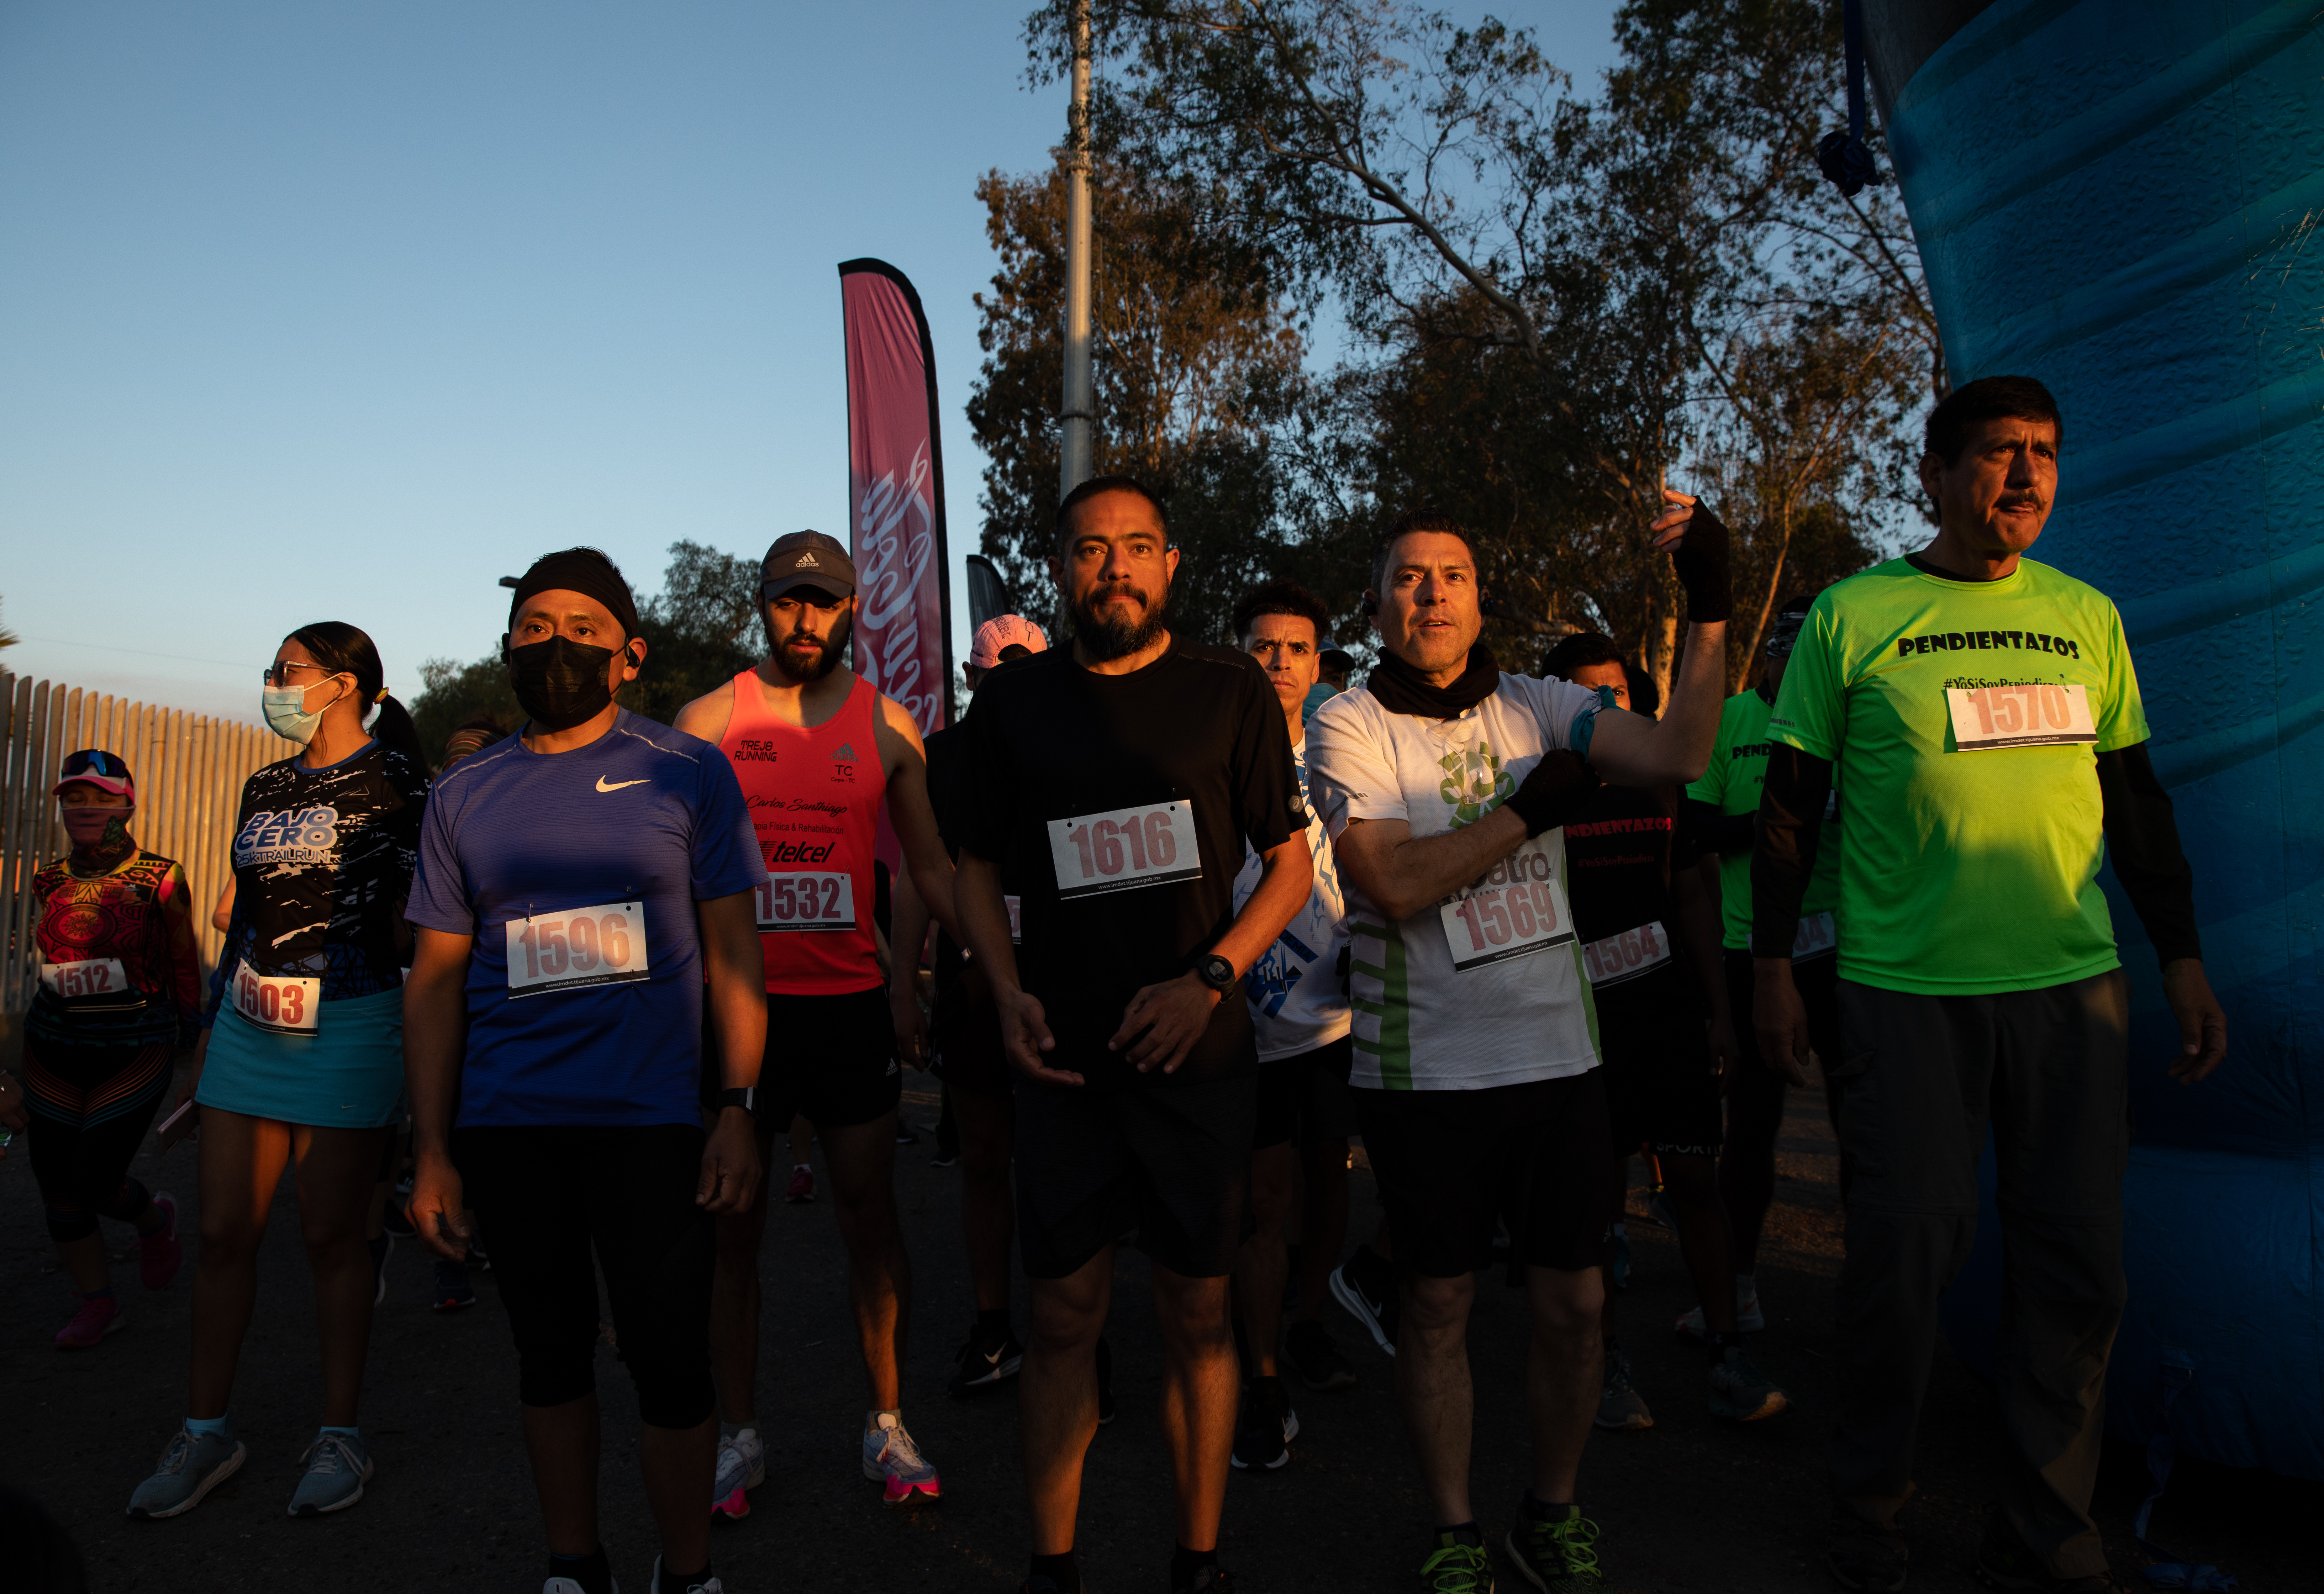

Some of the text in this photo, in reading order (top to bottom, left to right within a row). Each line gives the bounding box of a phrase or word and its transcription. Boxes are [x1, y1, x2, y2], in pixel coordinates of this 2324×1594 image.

[1898, 630, 2080, 660] PENDIENTAZOS
[1968, 685, 2071, 734] 1570
[734, 751, 777, 762] RUNNING
[741, 740, 773, 751] TREJO
[830, 753, 859, 762] adidas
[835, 765, 853, 776] TC
[747, 795, 848, 817] Carlos Santhiago
[245, 809, 334, 831] BAJO
[753, 822, 843, 834] apia Física & Rehabilitación
[1564, 817, 1671, 839] NDIENTAZOS
[236, 826, 333, 850] CERO
[1069, 811, 1176, 878] 1616
[773, 841, 836, 863] telcel
[1098, 876, 1161, 890] www.imdet.tijuana.gob.mx
[1466, 853, 1549, 890] atro
[757, 877, 841, 920] 1532
[1456, 881, 1557, 951] 1569
[519, 913, 630, 978] 1596
[1279, 929, 1311, 961] DEMIA
[1495, 941, 1548, 959] www.imdet.tijuana.gob.mx
[1584, 924, 1660, 977] 1564
[54, 964, 112, 997] 1512
[546, 976, 609, 988] www.imdet.tijuana.gob.mx
[240, 972, 304, 1024] 1503
